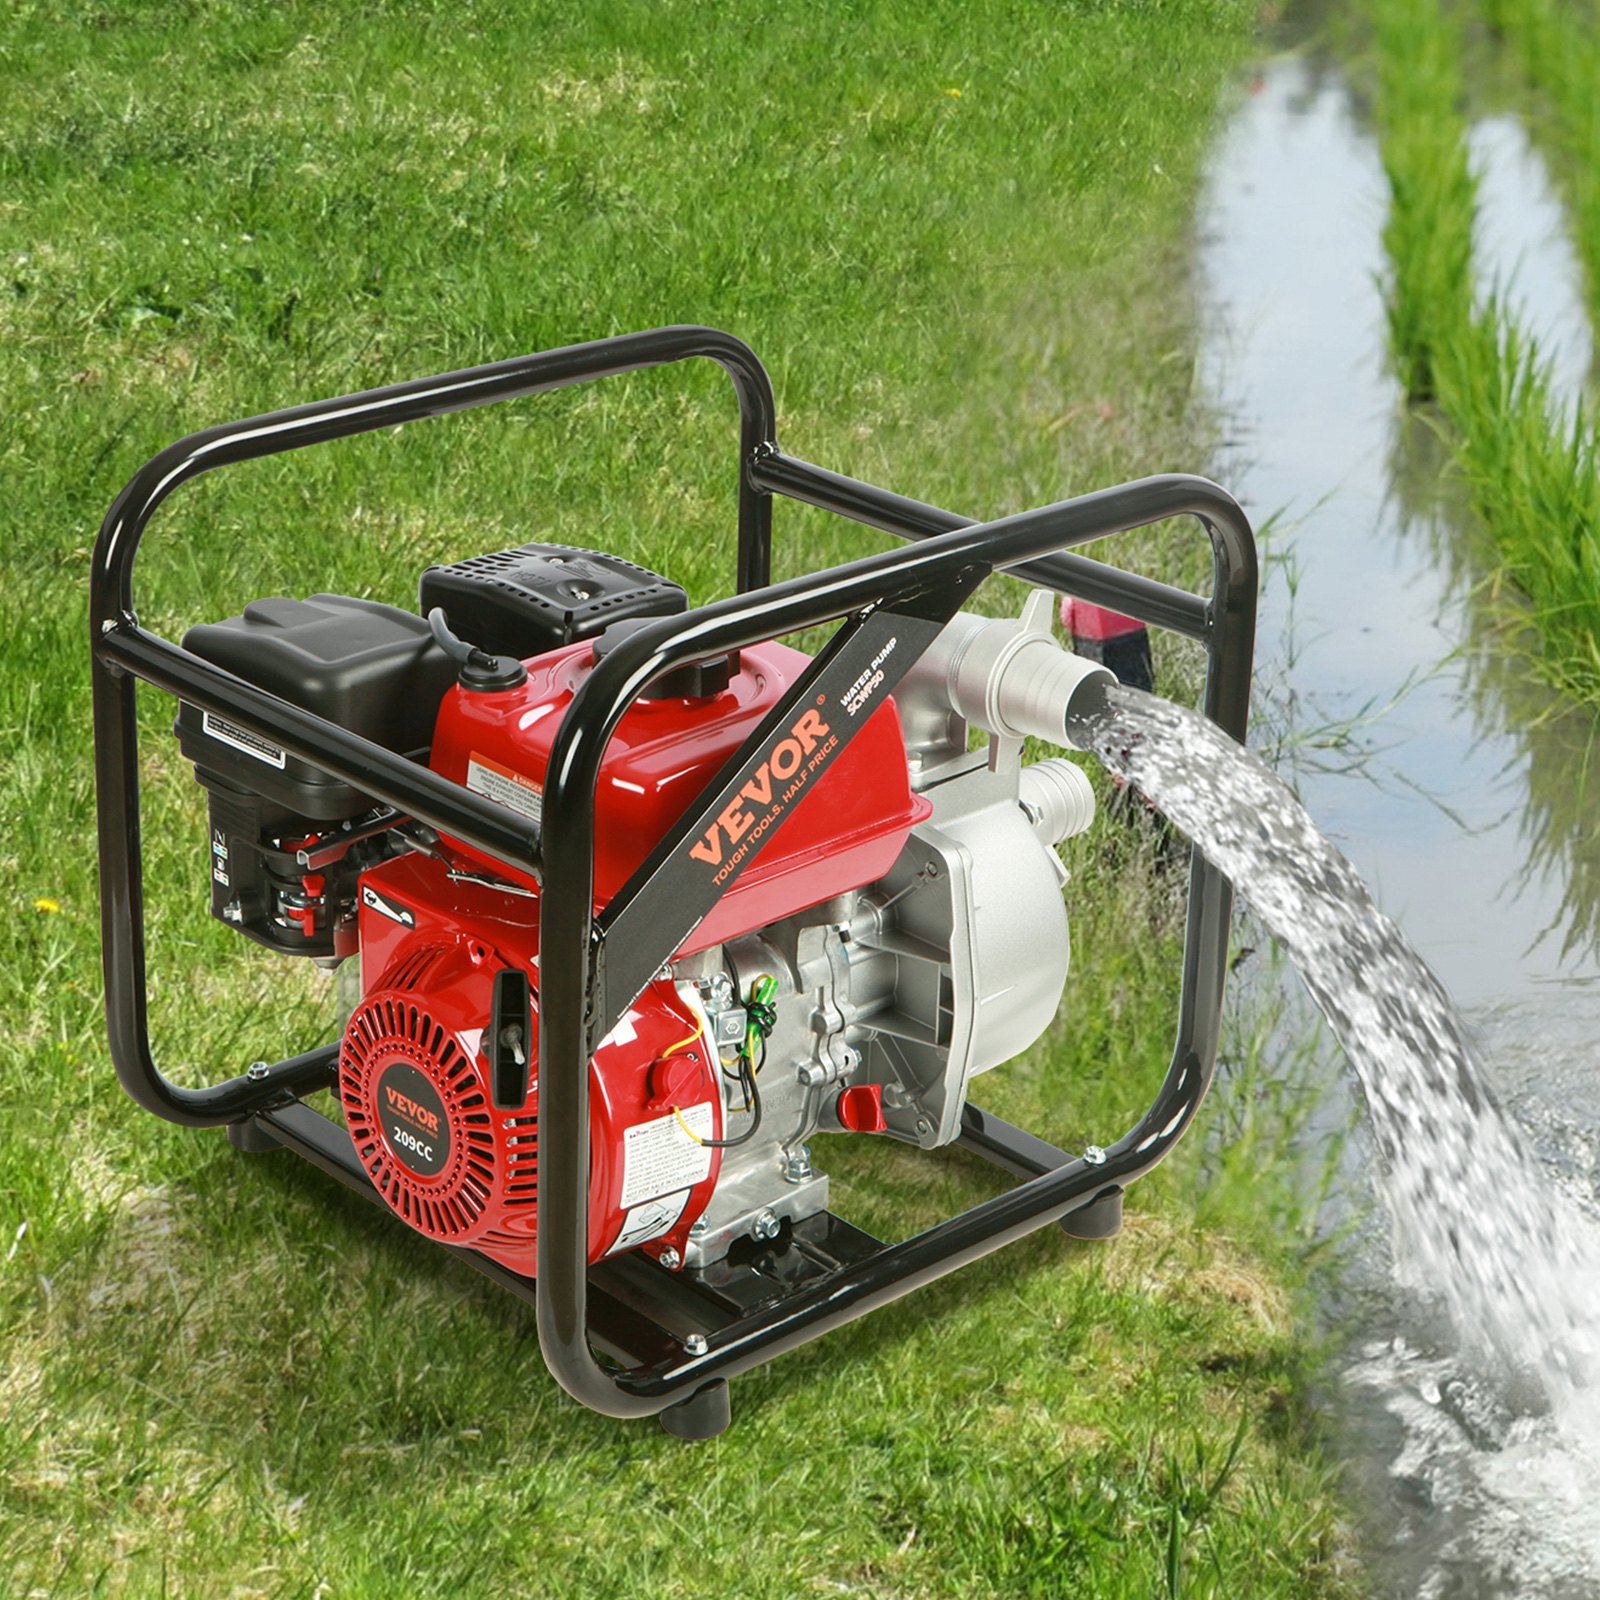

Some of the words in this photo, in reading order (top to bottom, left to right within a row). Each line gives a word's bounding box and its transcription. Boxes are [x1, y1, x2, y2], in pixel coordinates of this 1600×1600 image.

[840, 668, 872, 706] WATER
[870, 637, 897, 671] PUMP
[847, 669, 884, 716] SCWP50
[688, 708, 830, 867] VEVOR
[712, 843, 749, 886] TOUGH
[747, 803, 785, 845] TOOLS,
[782, 771, 809, 804] HALF
[808, 734, 839, 773] PRICE
[385, 1086, 438, 1132] VEVOR
[394, 1126, 433, 1162] 209CC
